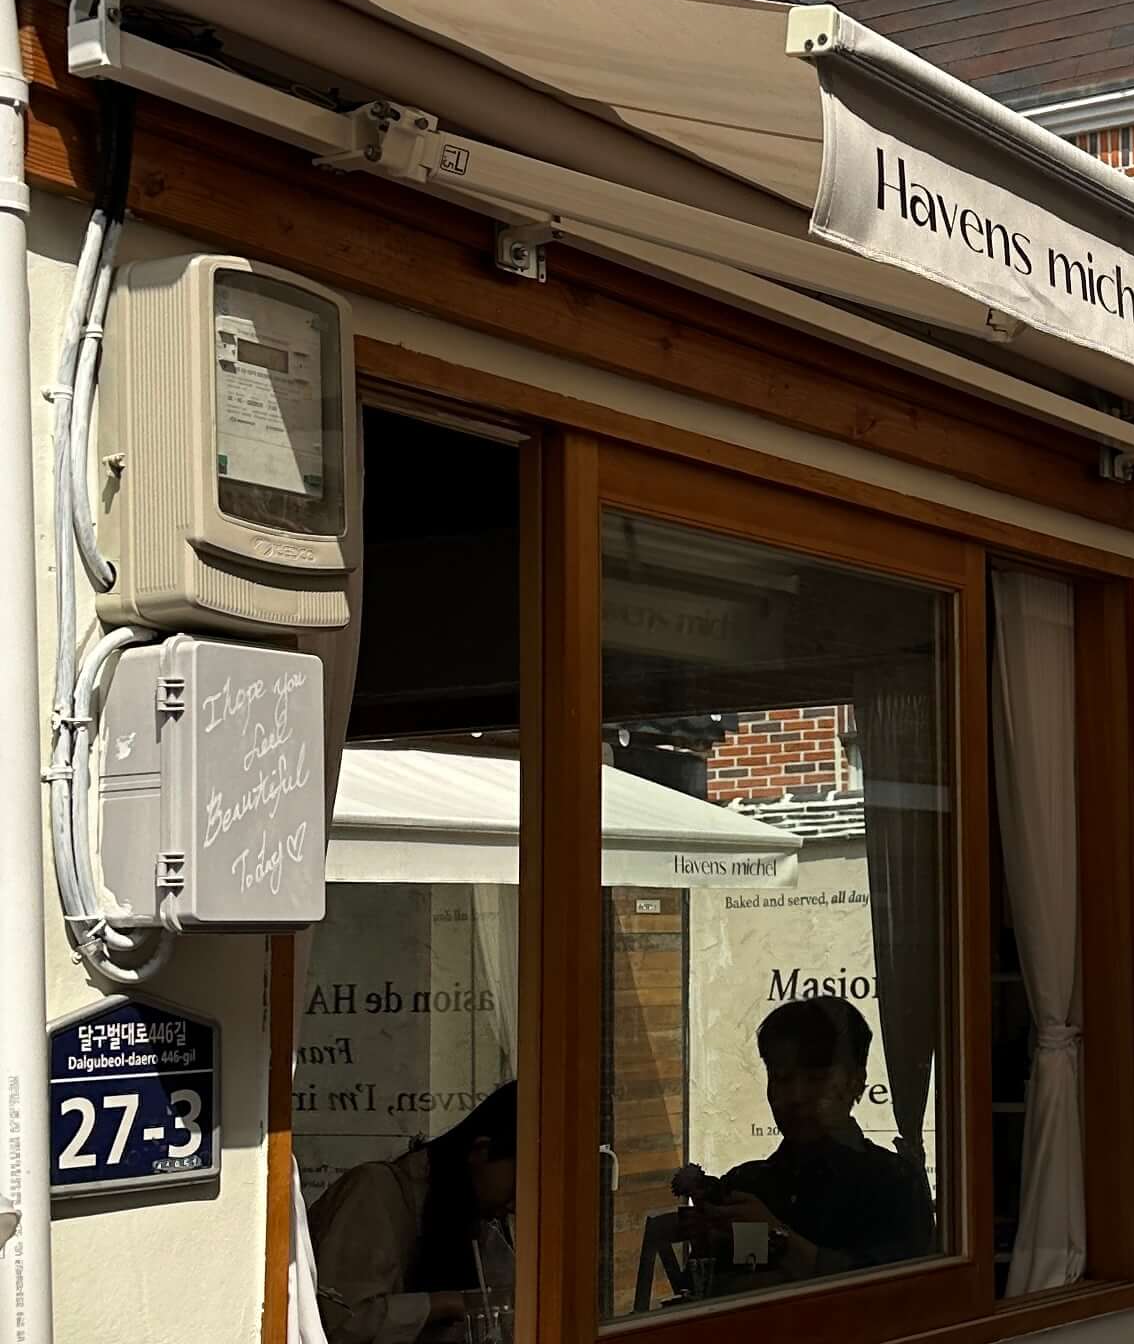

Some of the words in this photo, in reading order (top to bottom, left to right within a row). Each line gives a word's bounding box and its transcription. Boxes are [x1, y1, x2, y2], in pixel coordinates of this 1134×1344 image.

[876, 146, 1033, 275] Havens
[273, 671, 307, 741] you
[203, 741, 310, 848] Beautiful
[231, 829, 283, 895] Today
[673, 854, 728, 876] Havens
[730, 858, 778, 878] michel
[725, 894, 760, 909] Baked
[762, 893, 785, 908] and
[787, 891, 829, 907] served,
[830, 889, 846, 906] all
[848, 889, 869, 907] day
[67, 1050, 159, 1073] Dalgubeol-daero
[160, 1047, 197, 1066] 446-gil
[77, 1019, 187, 1053] 달구벌대로446길
[58, 1088, 202, 1171] 27-3
